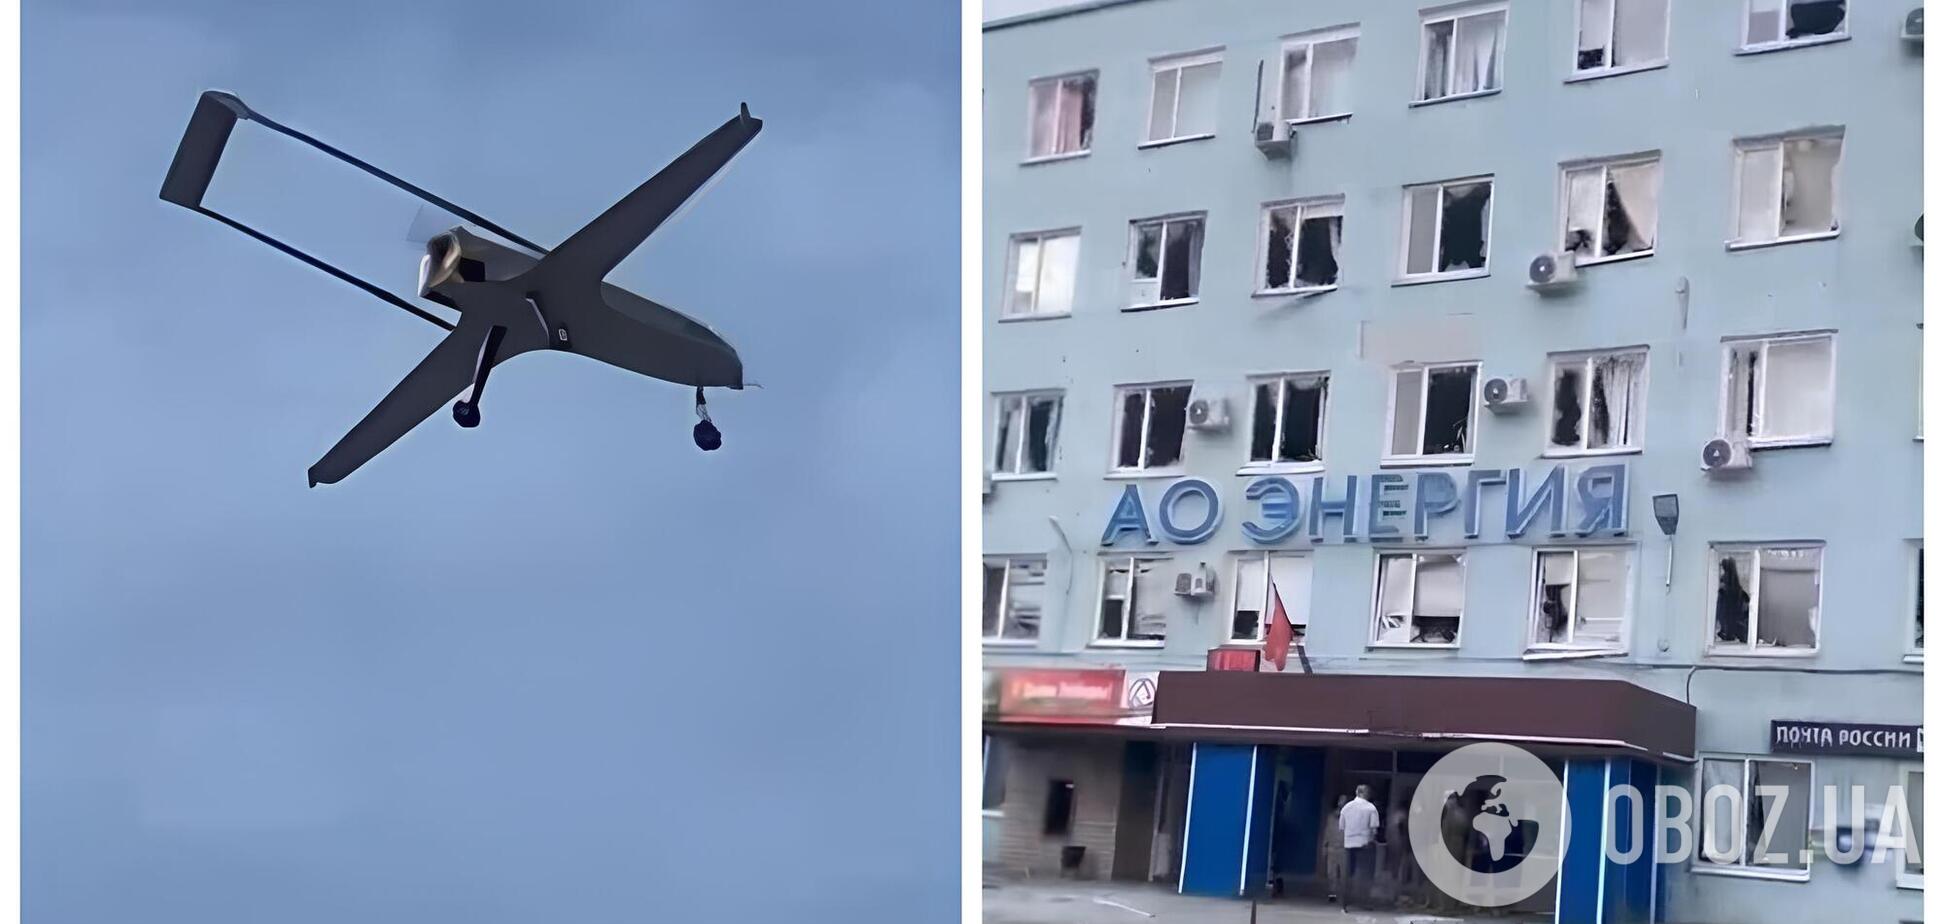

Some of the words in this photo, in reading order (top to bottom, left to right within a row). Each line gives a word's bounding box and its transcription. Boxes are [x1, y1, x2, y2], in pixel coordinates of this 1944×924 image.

[1101, 478, 1225, 545] АО
[1241, 463, 1631, 544] ЭНЕРГИЯ
[1777, 726, 1833, 747] ПОЧТА
[1839, 729, 1911, 748] РОССИИ
